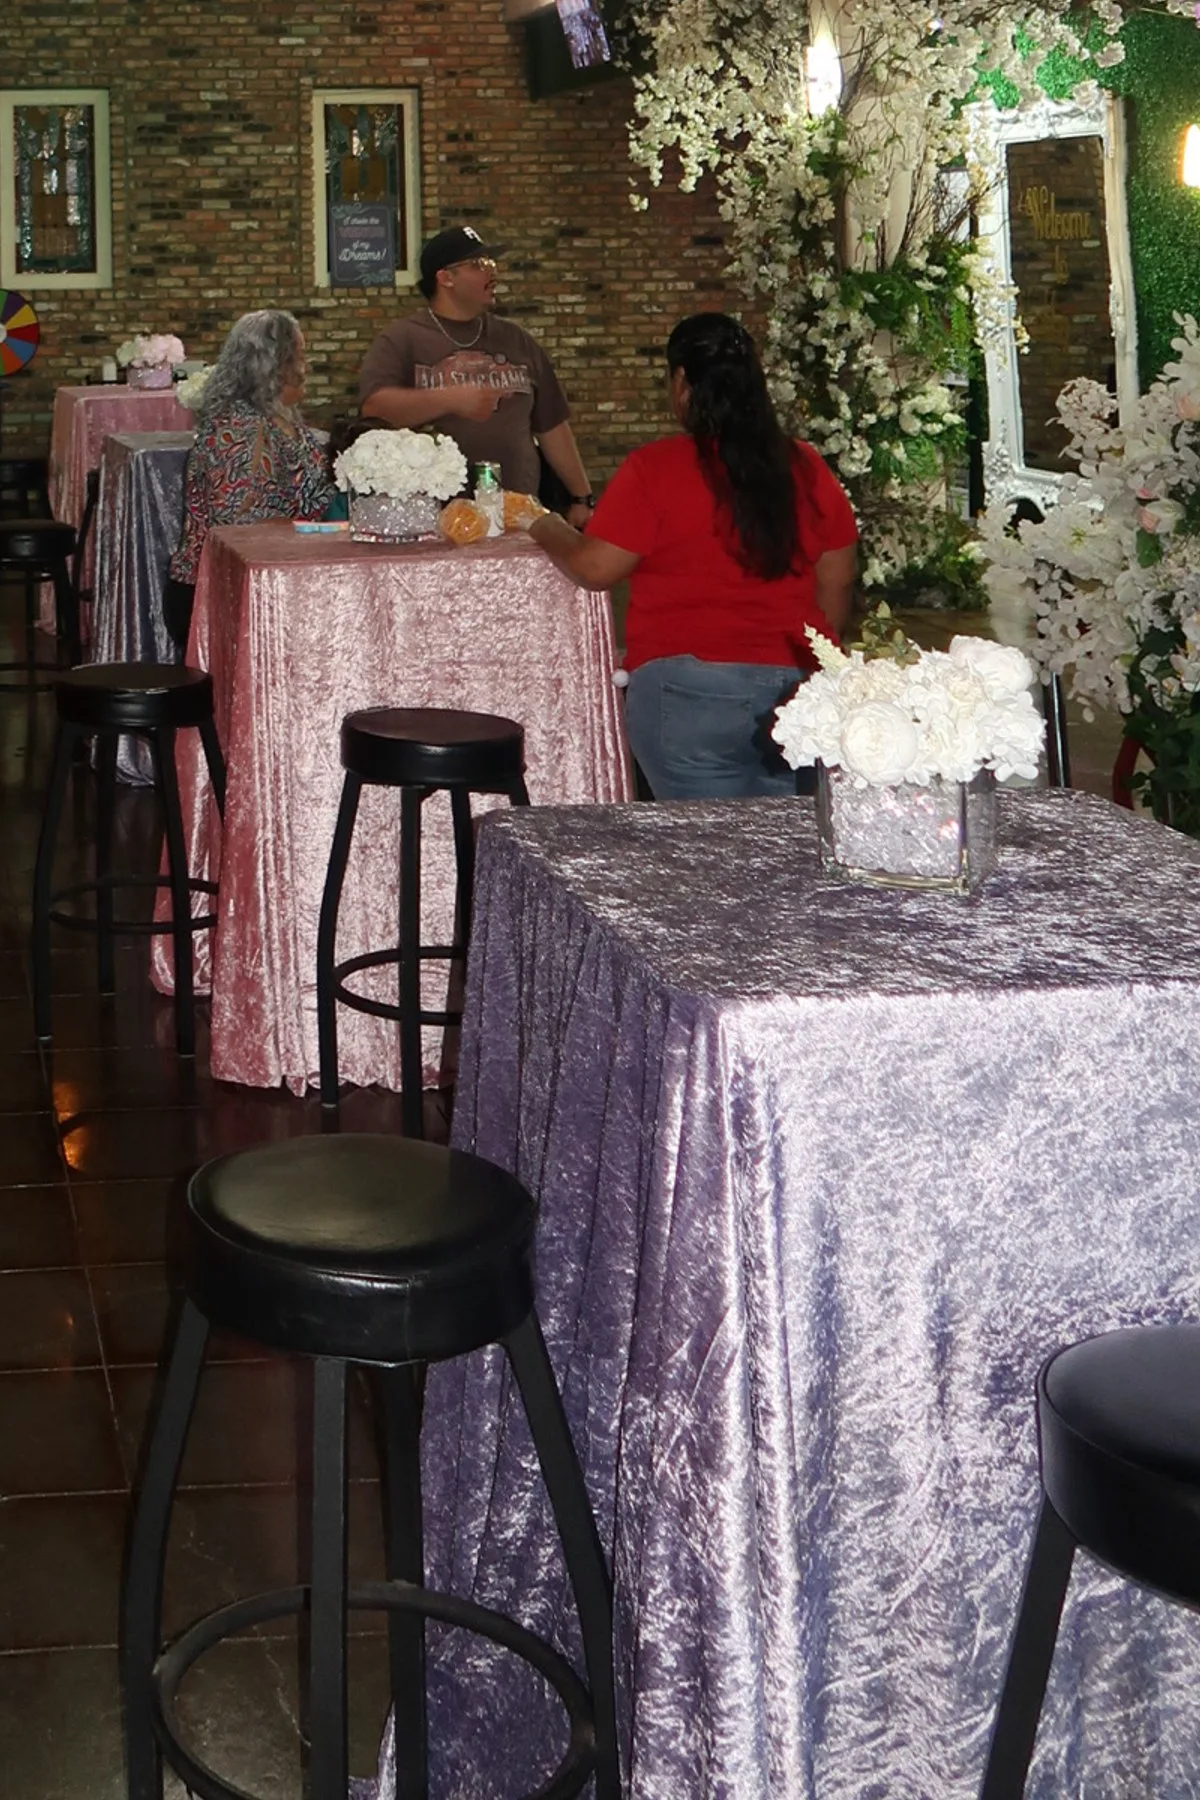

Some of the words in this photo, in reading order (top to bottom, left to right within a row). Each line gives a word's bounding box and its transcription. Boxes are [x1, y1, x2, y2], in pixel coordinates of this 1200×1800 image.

[1017, 186, 1091, 240] Welcome
[339, 248, 387, 262] Dreams!
[421, 369, 445, 390] ALL
[451, 371, 486, 389] STAR
[489, 367, 531, 389] GAME
